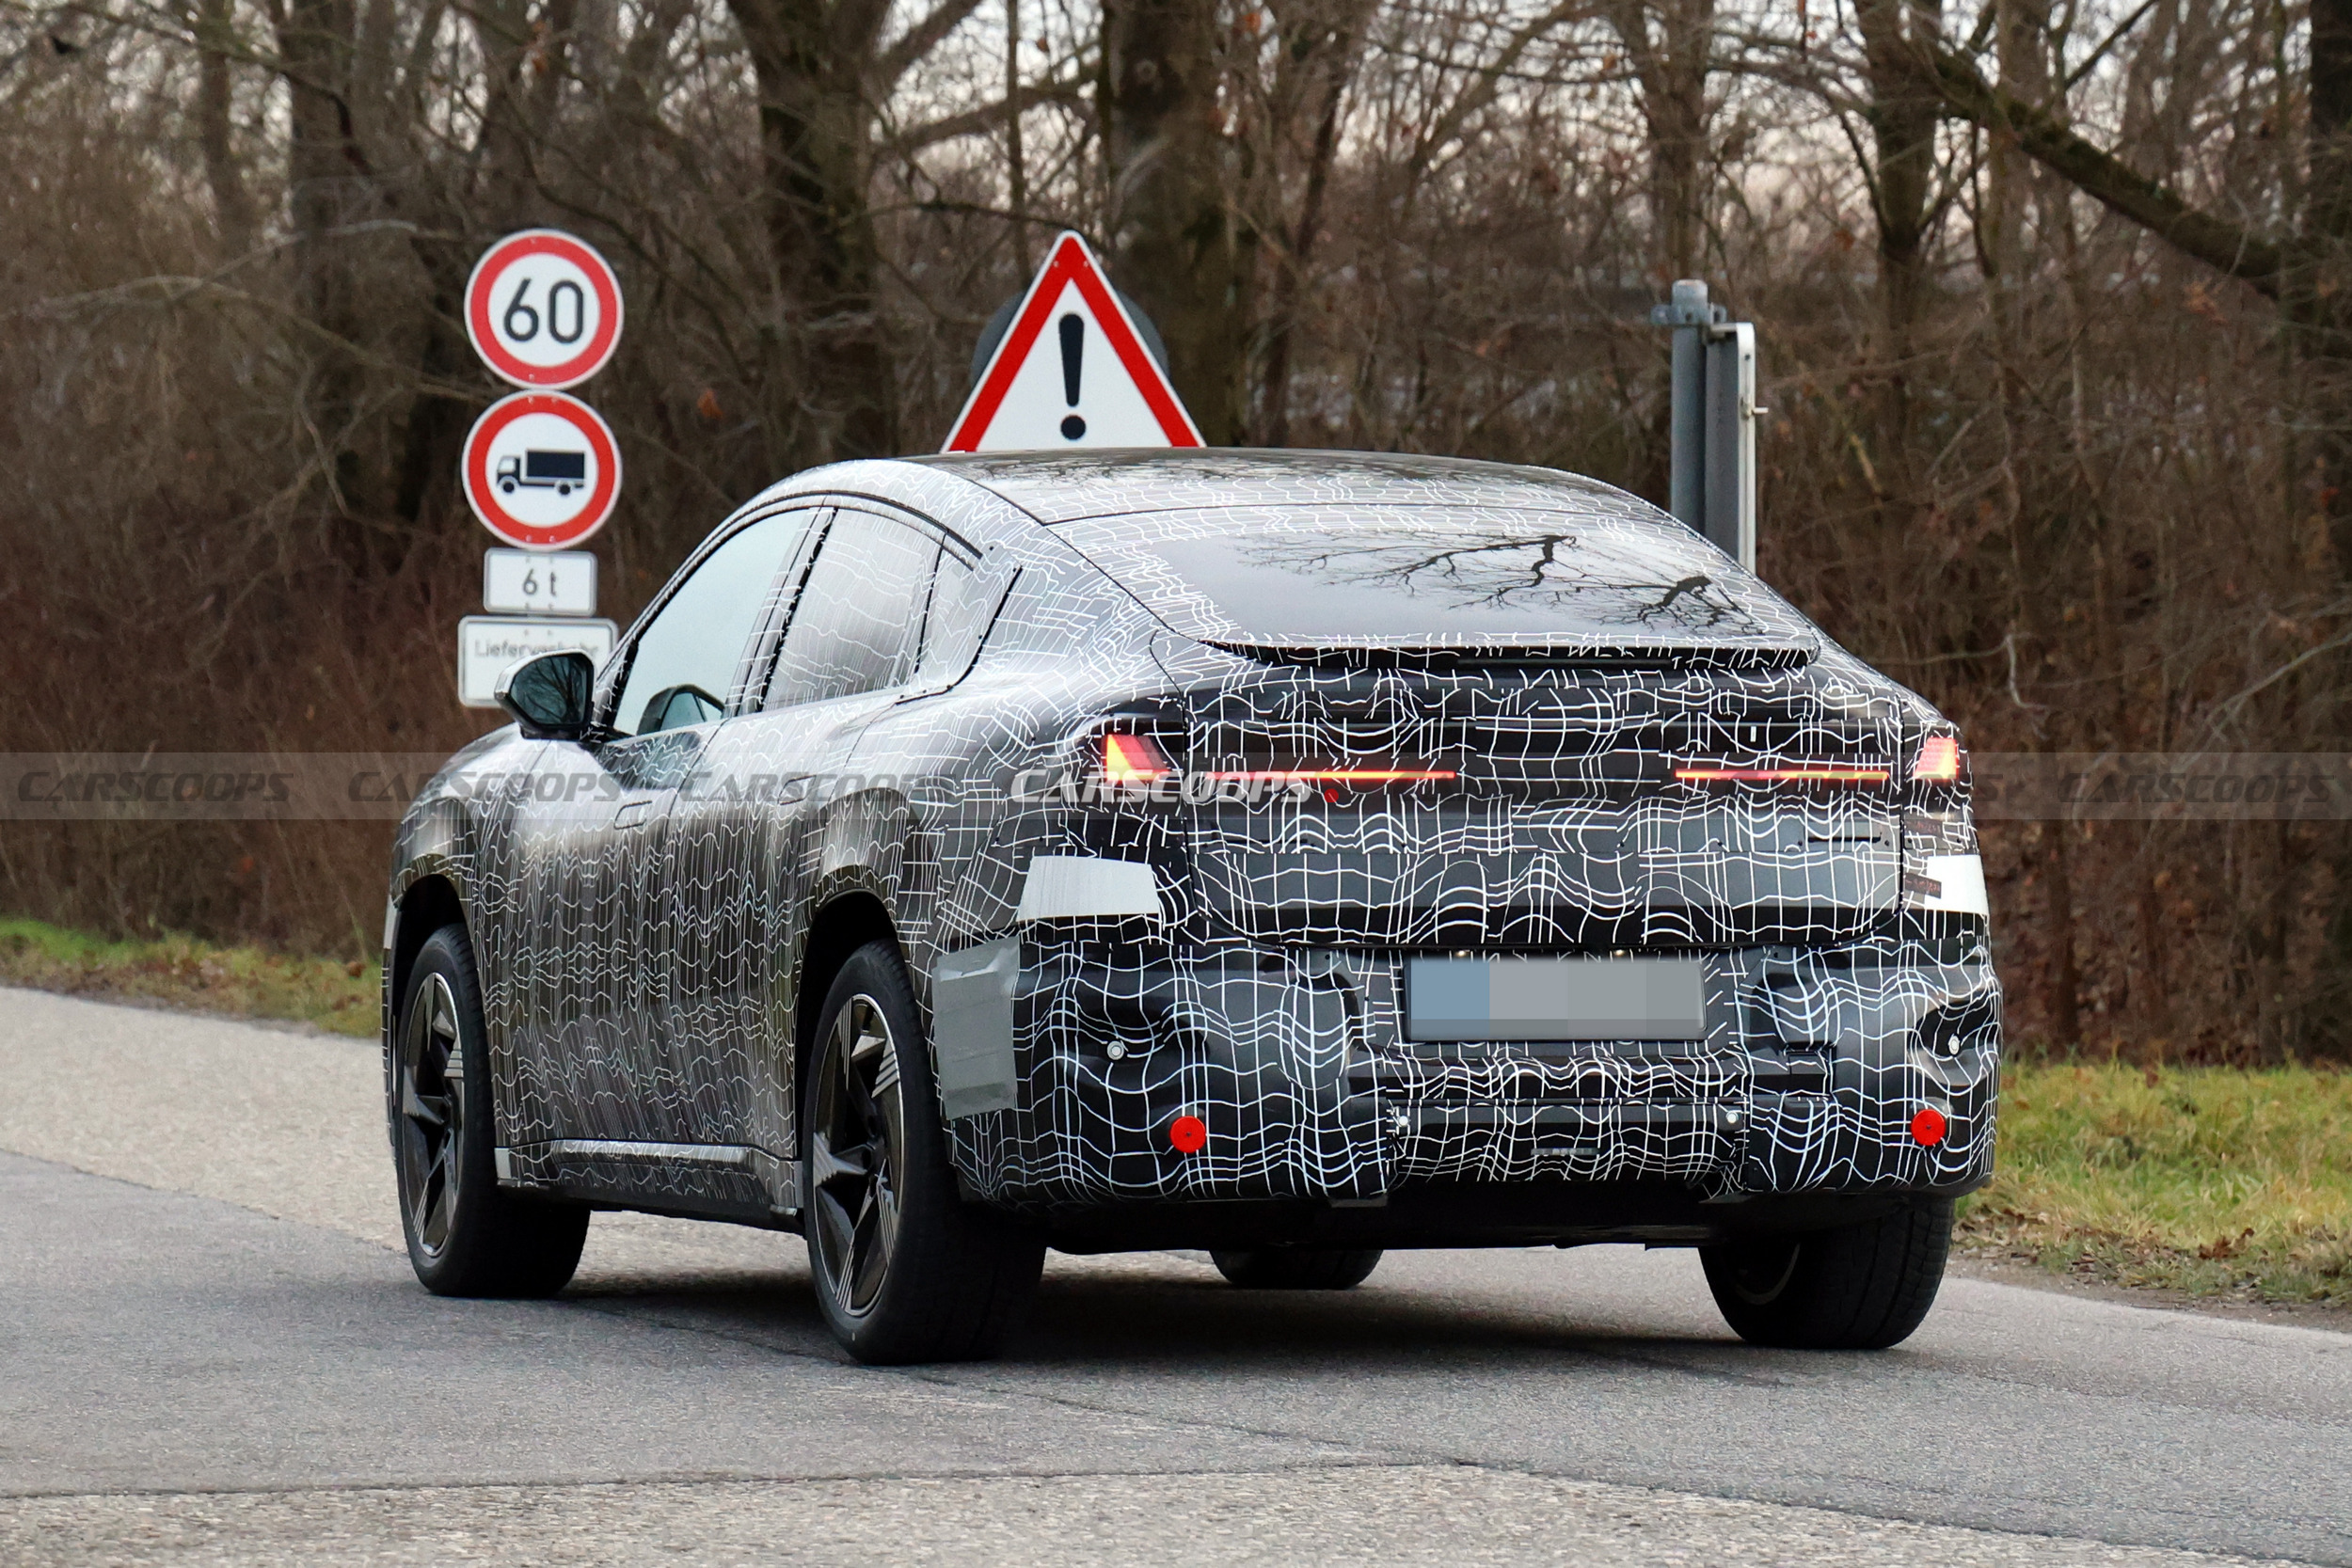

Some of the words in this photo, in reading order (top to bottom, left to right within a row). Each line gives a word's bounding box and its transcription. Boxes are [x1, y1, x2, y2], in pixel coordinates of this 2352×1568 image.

[503, 278, 584, 343] 60
[523, 568, 538, 595] 6
[548, 572, 558, 596] t
